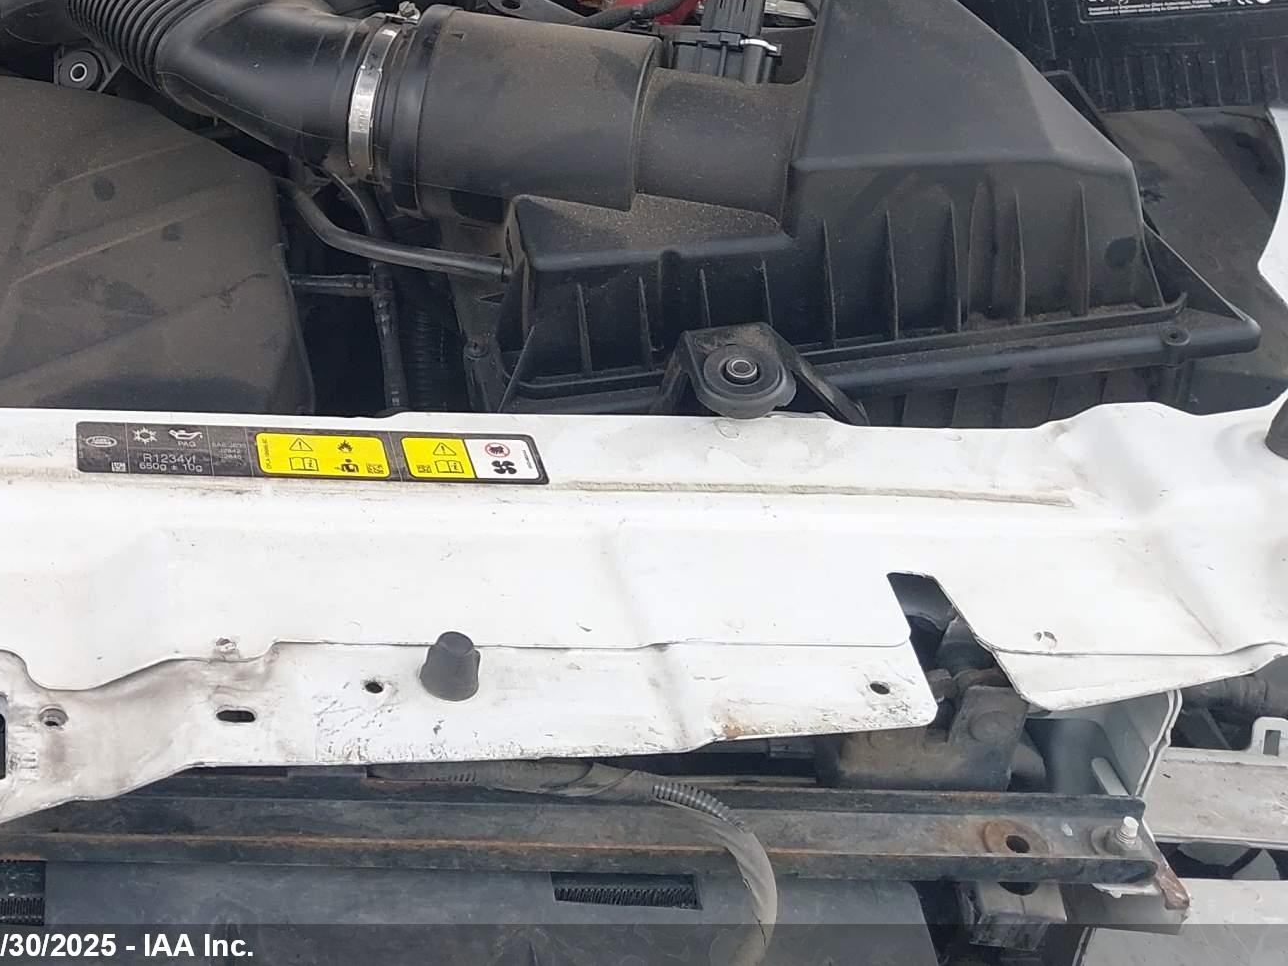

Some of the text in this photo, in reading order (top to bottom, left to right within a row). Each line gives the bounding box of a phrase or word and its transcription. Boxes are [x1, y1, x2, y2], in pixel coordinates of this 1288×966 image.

[142, 453, 197, 464] R1234yf
[139, 462, 167, 472] 650g
[182, 464, 204, 473] 10g
